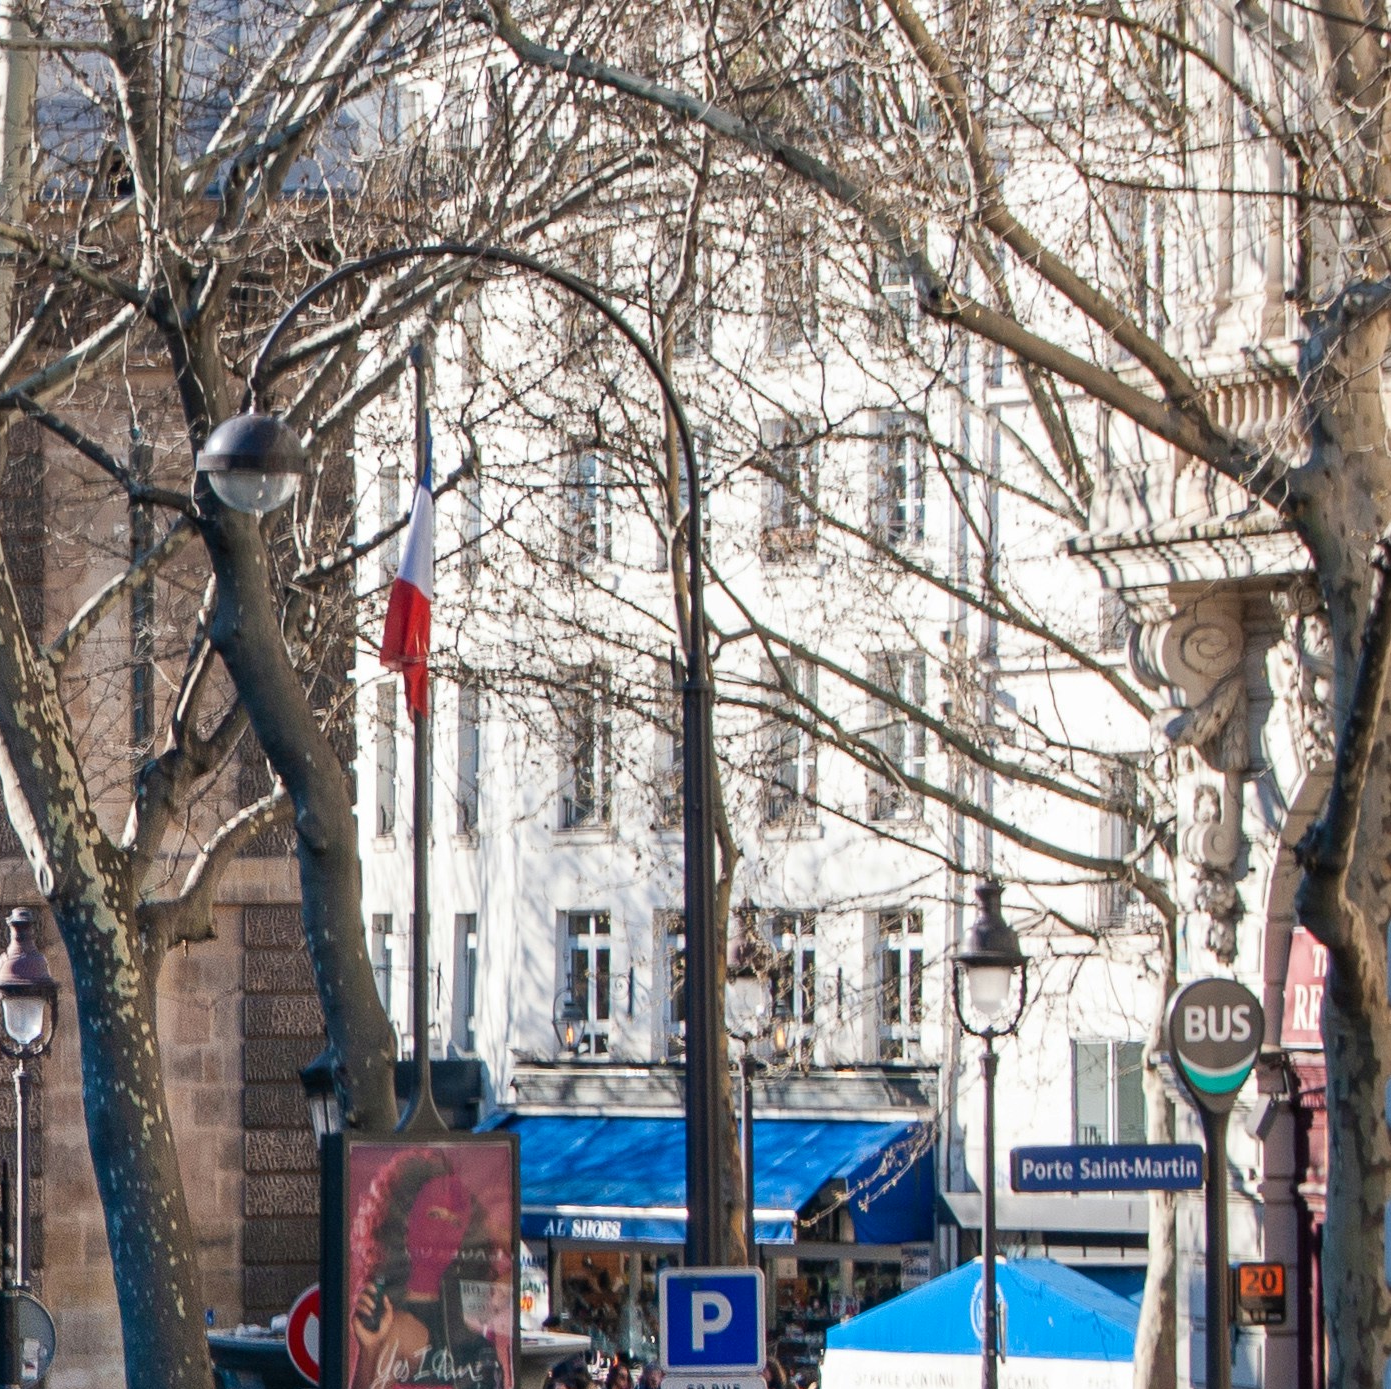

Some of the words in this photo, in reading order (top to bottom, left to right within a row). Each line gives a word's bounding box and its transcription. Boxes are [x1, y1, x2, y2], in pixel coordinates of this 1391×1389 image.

[1184, 1004, 1251, 1042] BUS
[1022, 1157, 1073, 1180] Porte
[1080, 1155, 1198, 1180] Saint-Martin
[571, 1218, 622, 1240] SHOES
[1246, 1269, 1277, 1293] 20
[691, 1290, 733, 1351] P
[995, 1376, 1049, 1389] OCKTAILS
